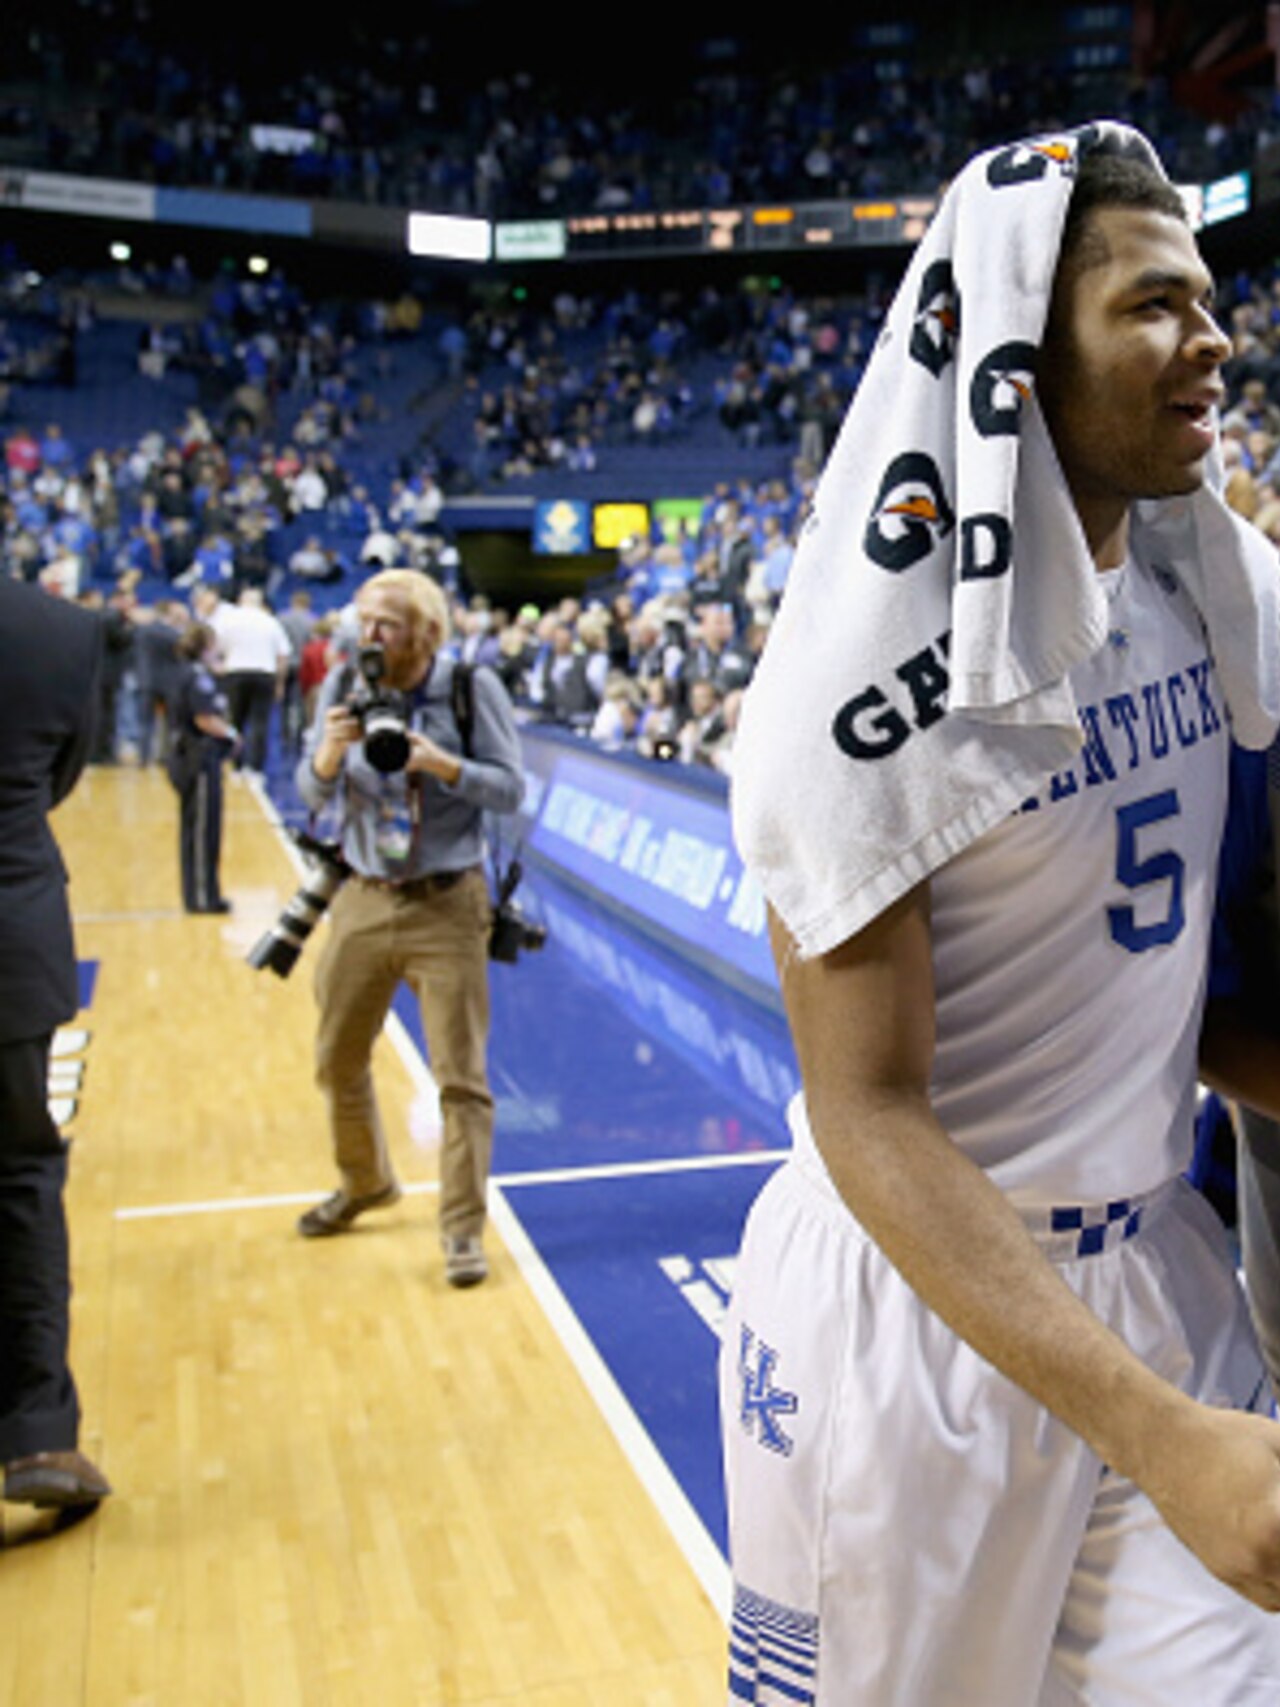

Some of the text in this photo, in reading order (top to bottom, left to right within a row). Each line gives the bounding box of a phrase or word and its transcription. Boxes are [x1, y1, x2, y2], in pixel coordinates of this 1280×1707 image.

[961, 514, 1012, 581] D
[831, 630, 951, 761] GA
[1106, 789, 1186, 953] 5
